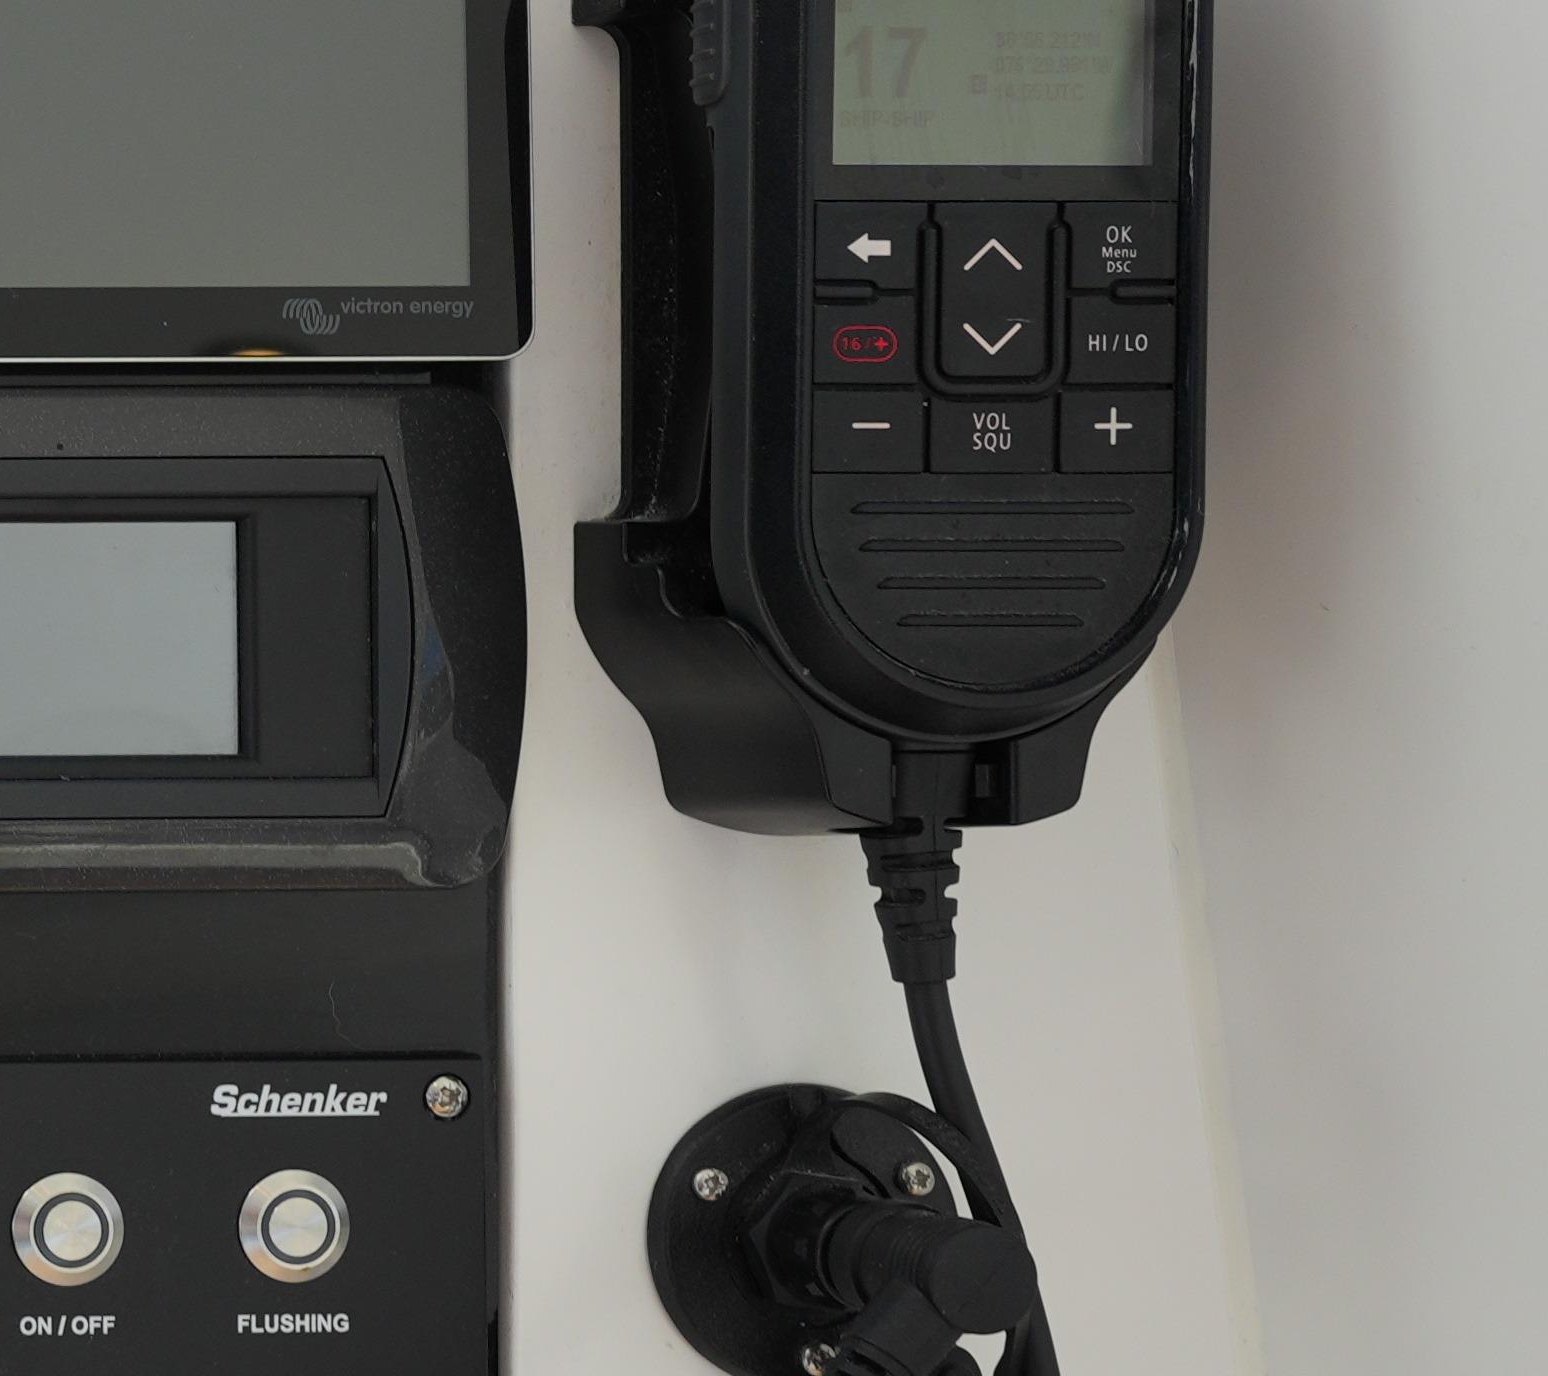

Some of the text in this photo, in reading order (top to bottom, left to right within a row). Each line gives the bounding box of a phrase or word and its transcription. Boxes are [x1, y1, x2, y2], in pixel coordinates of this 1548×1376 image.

[845, 26, 928, 98] 17
[1106, 225, 1133, 244] OK
[1101, 246, 1137, 258] Menu
[1106, 260, 1132, 273] DSC
[340, 296, 474, 319] victron energy
[972, 412, 1011, 431] VOL
[972, 432, 1011, 453] SQU
[210, 1083, 388, 1118] Schenker
[237, 1312, 350, 1334] FLUSHING
